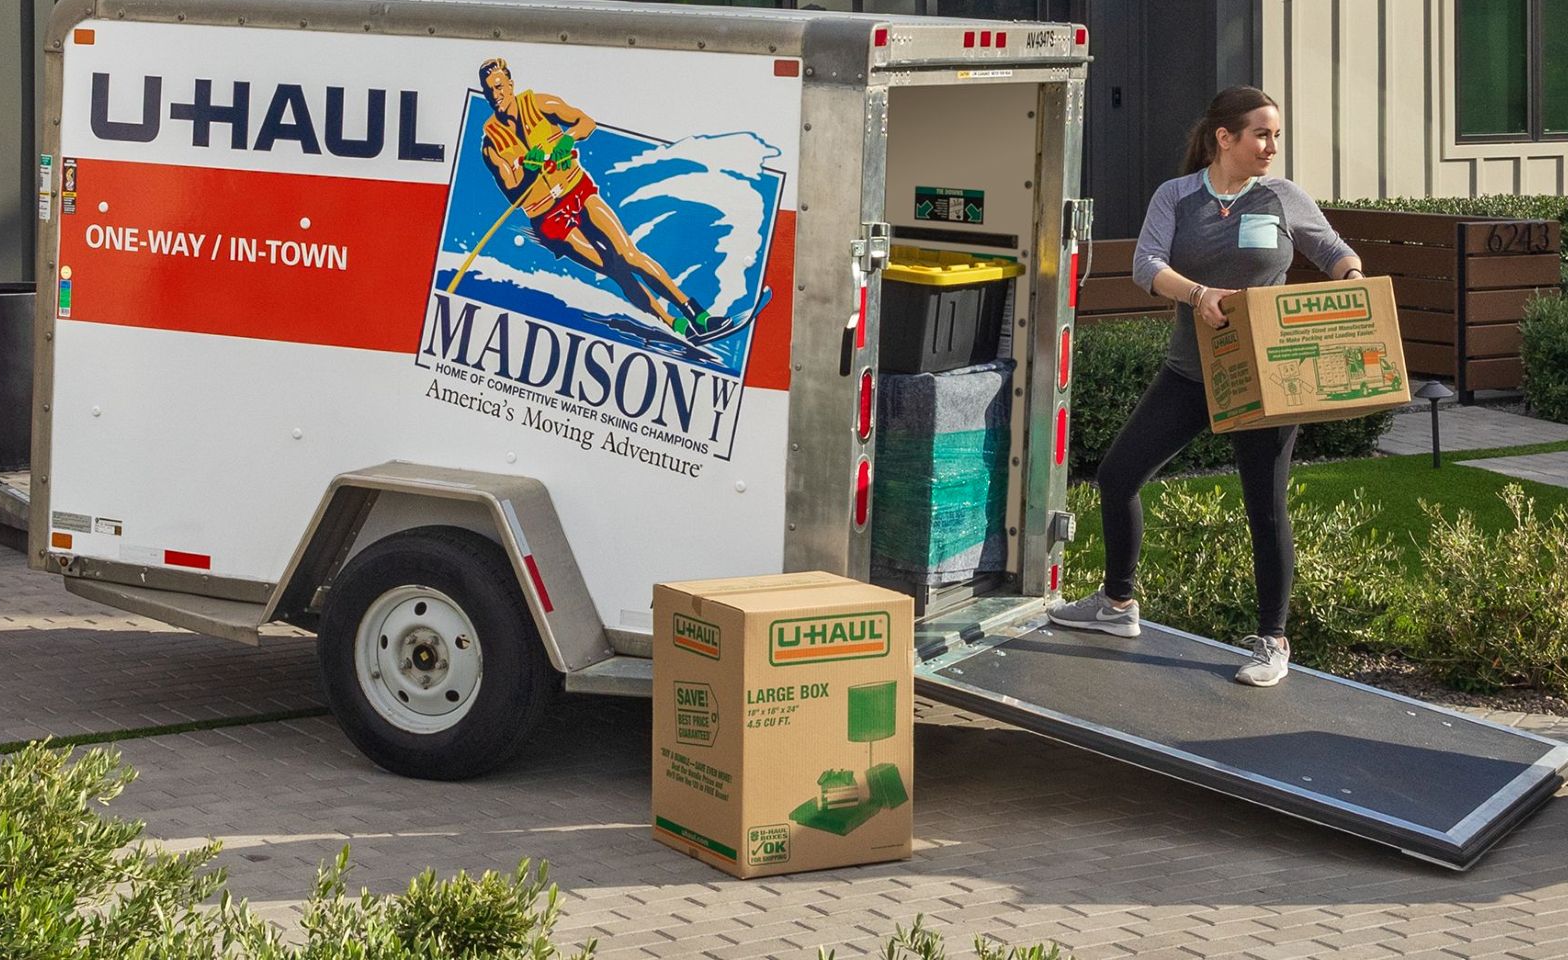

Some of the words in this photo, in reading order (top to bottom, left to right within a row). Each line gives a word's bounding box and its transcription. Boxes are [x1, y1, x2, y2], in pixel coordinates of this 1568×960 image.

[90, 72, 446, 163] U-HAUL
[85, 223, 206, 261] ONE-WAY
[210, 233, 223, 262] /
[229, 237, 348, 271] IN-TOWN
[1283, 293, 1364, 315] U-HAUL
[423, 293, 706, 434] MADISON
[425, 378, 515, 422] America's
[521, 406, 595, 450] Moving
[435, 362, 469, 382] HOME
[470, 370, 485, 385] OF
[487, 377, 559, 410] COMPETITIVE
[560, 399, 599, 422] WATER
[600, 411, 638, 434] SKIING
[640, 424, 709, 455] CHAMPIONS
[675, 619, 718, 647] U-HAUL
[777, 620, 882, 648] U-HAUL
[677, 688, 709, 708] SAVE!
[747, 686, 795, 705] LARGE
[800, 682, 829, 700] BOX
[693, 715, 709, 728] PRICE
[747, 719, 761, 728] 4.5
[763, 717, 776, 727] CU
[778, 716, 791, 726] FT.
[760, 833, 788, 841] BOXES
[763, 840, 786, 855] OK
